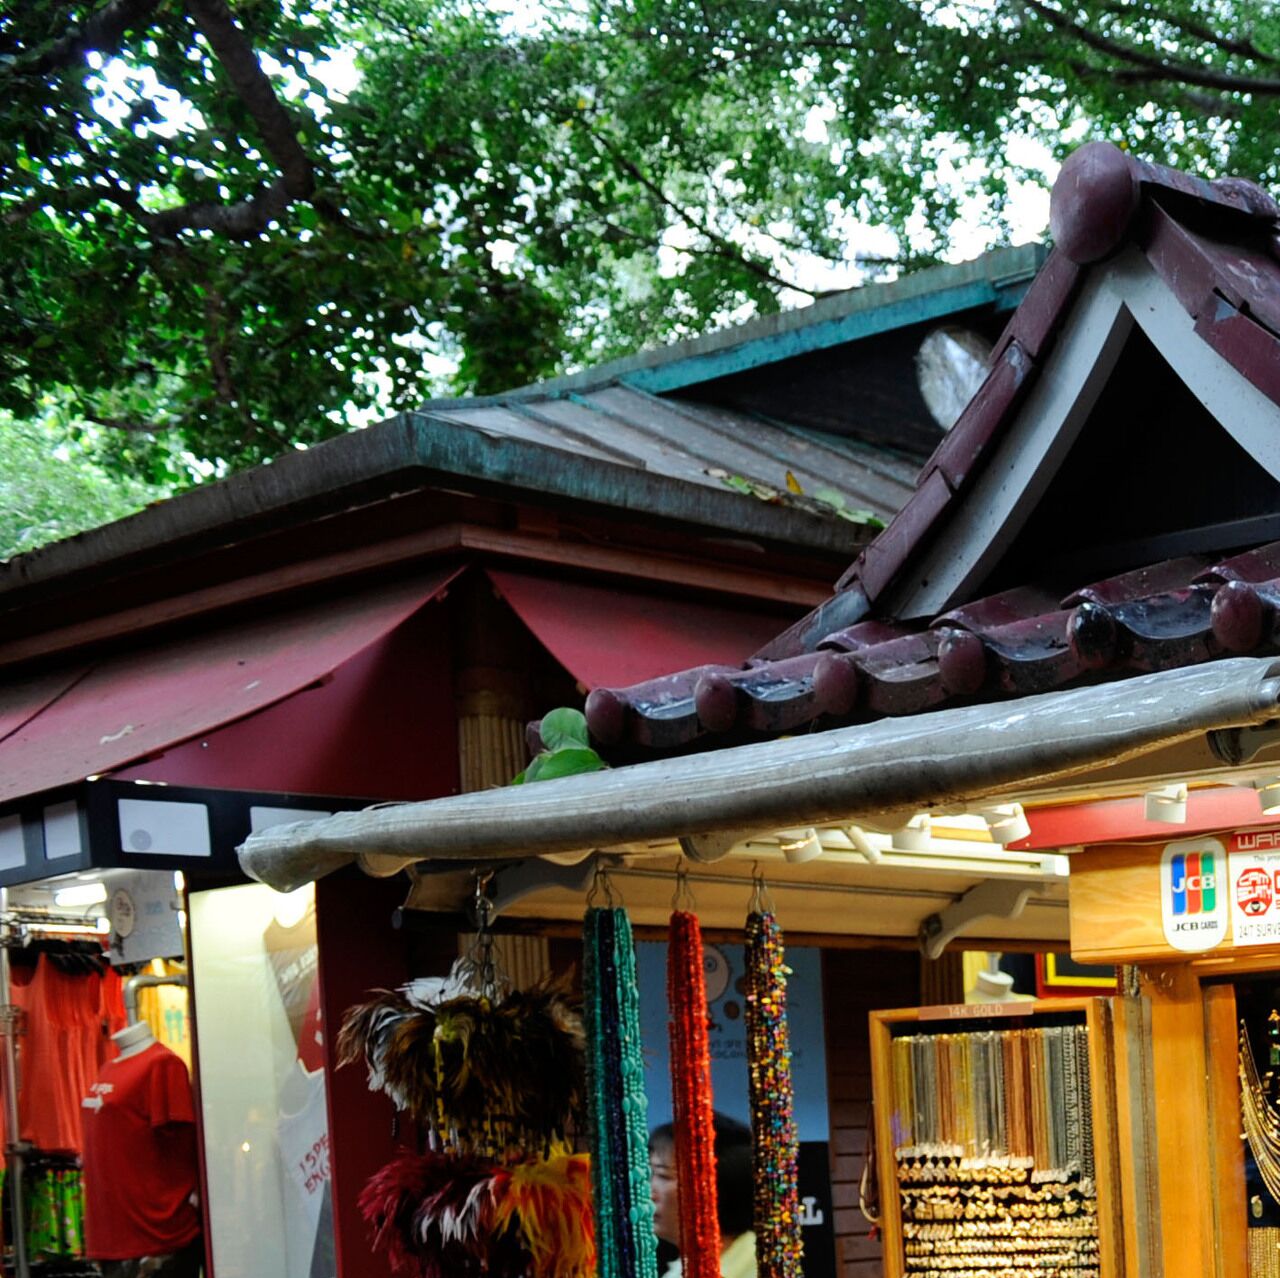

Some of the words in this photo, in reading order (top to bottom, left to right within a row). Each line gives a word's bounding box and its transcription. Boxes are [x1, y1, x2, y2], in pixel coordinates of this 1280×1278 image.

[1172, 875, 1215, 893] JCB
[1173, 922, 1199, 931] JCB
[948, 1005, 969, 1017] 14K
[973, 1004, 1003, 1016] GOLD
